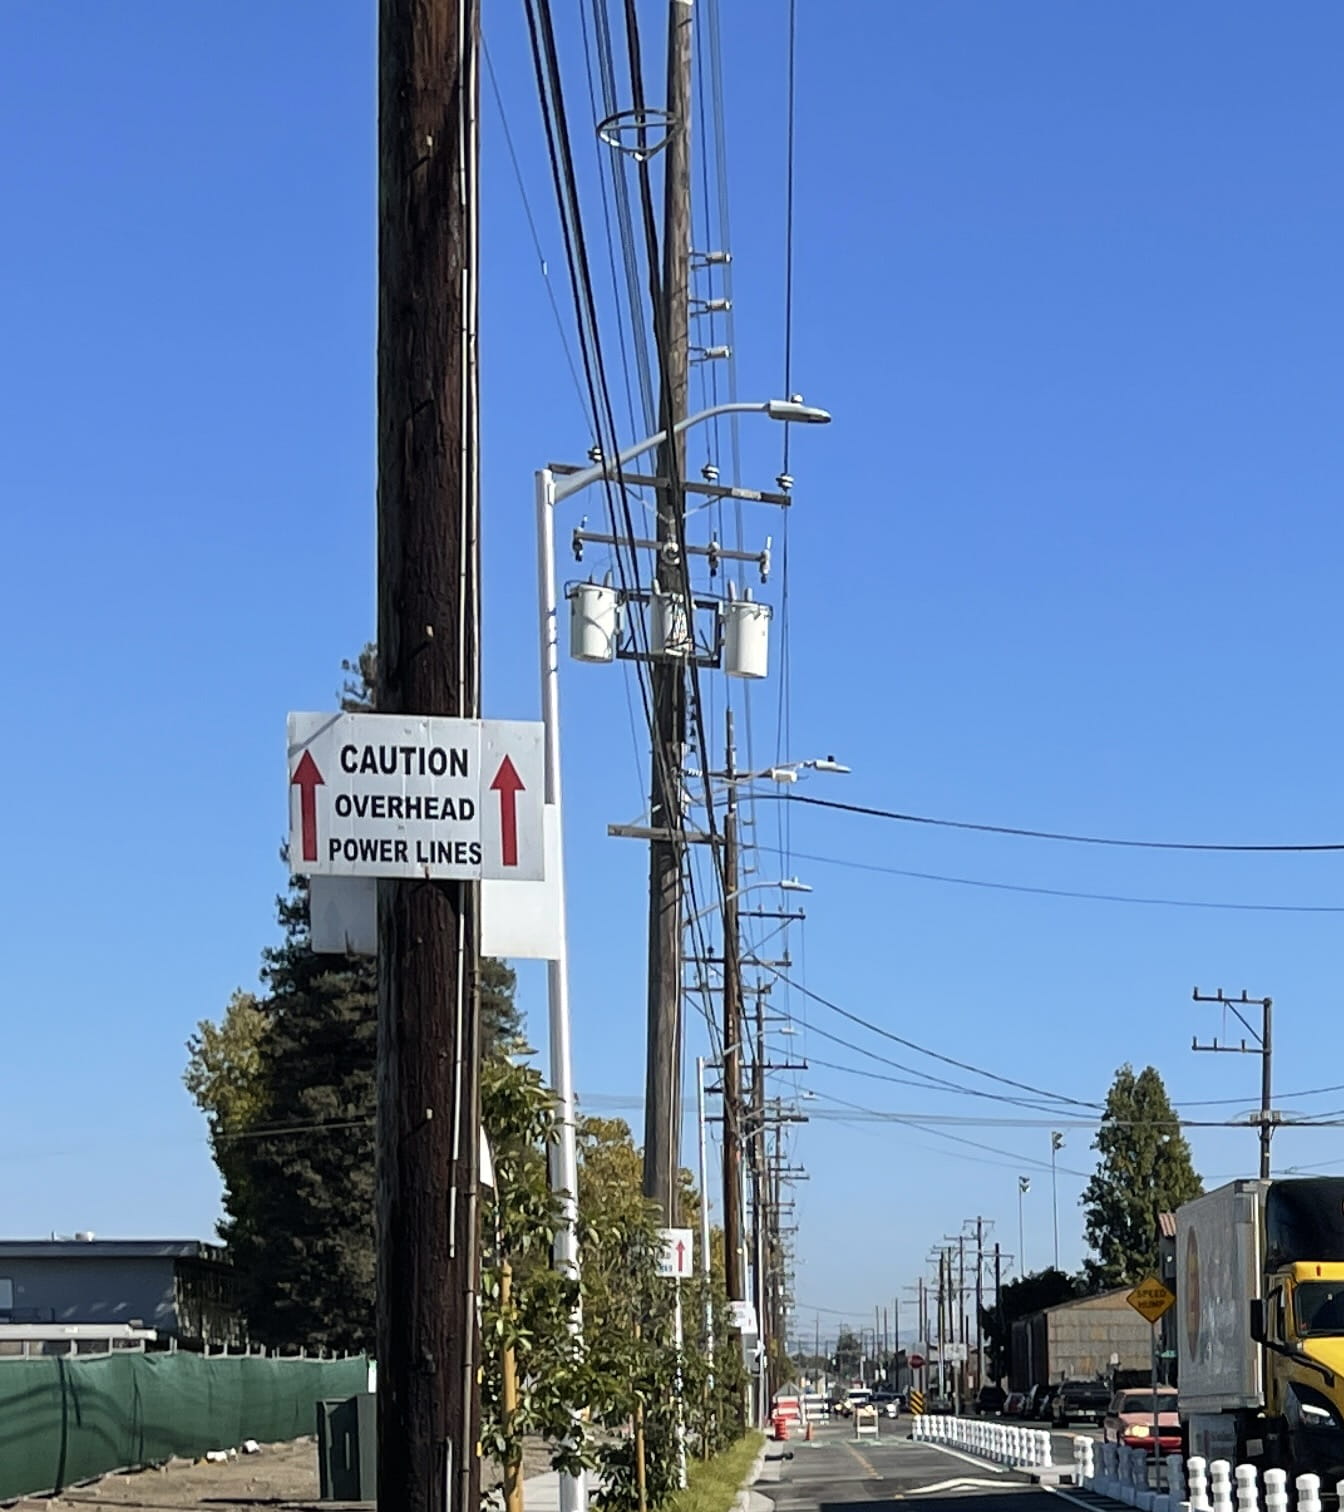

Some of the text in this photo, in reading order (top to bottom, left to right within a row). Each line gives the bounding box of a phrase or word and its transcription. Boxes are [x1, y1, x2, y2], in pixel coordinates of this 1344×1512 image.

[340, 744, 469, 778] CAUTION
[334, 794, 476, 822] OVERHEAD
[328, 838, 483, 867] POWER LINES
